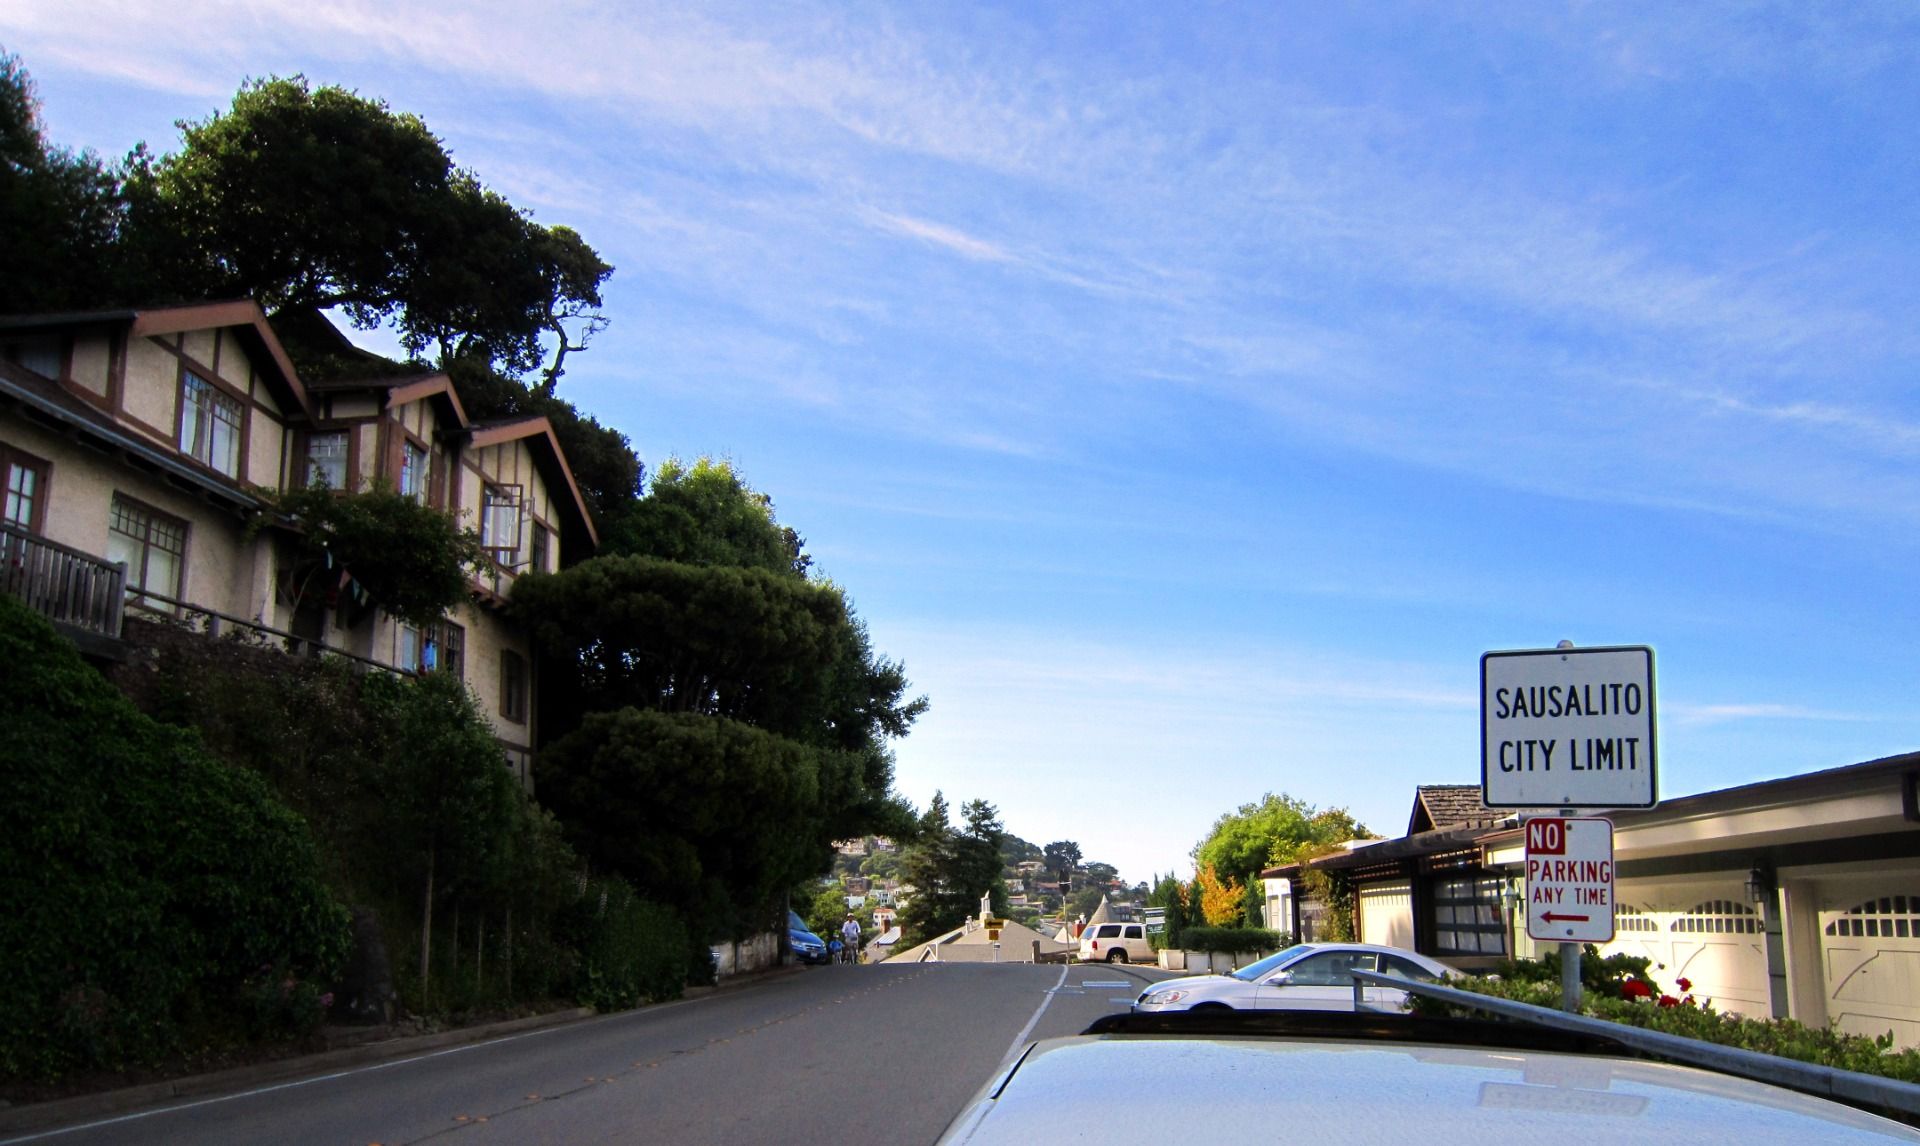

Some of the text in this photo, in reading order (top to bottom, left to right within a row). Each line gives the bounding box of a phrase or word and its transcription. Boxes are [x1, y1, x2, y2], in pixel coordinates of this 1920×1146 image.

[1496, 683, 1640, 719] SAUSALITO
[1500, 738, 1639, 772] CITY LIMIT
[1530, 823, 1560, 850] NO
[1529, 860, 1611, 883] PARKING
[1533, 888, 1607, 905] ANY TIME
